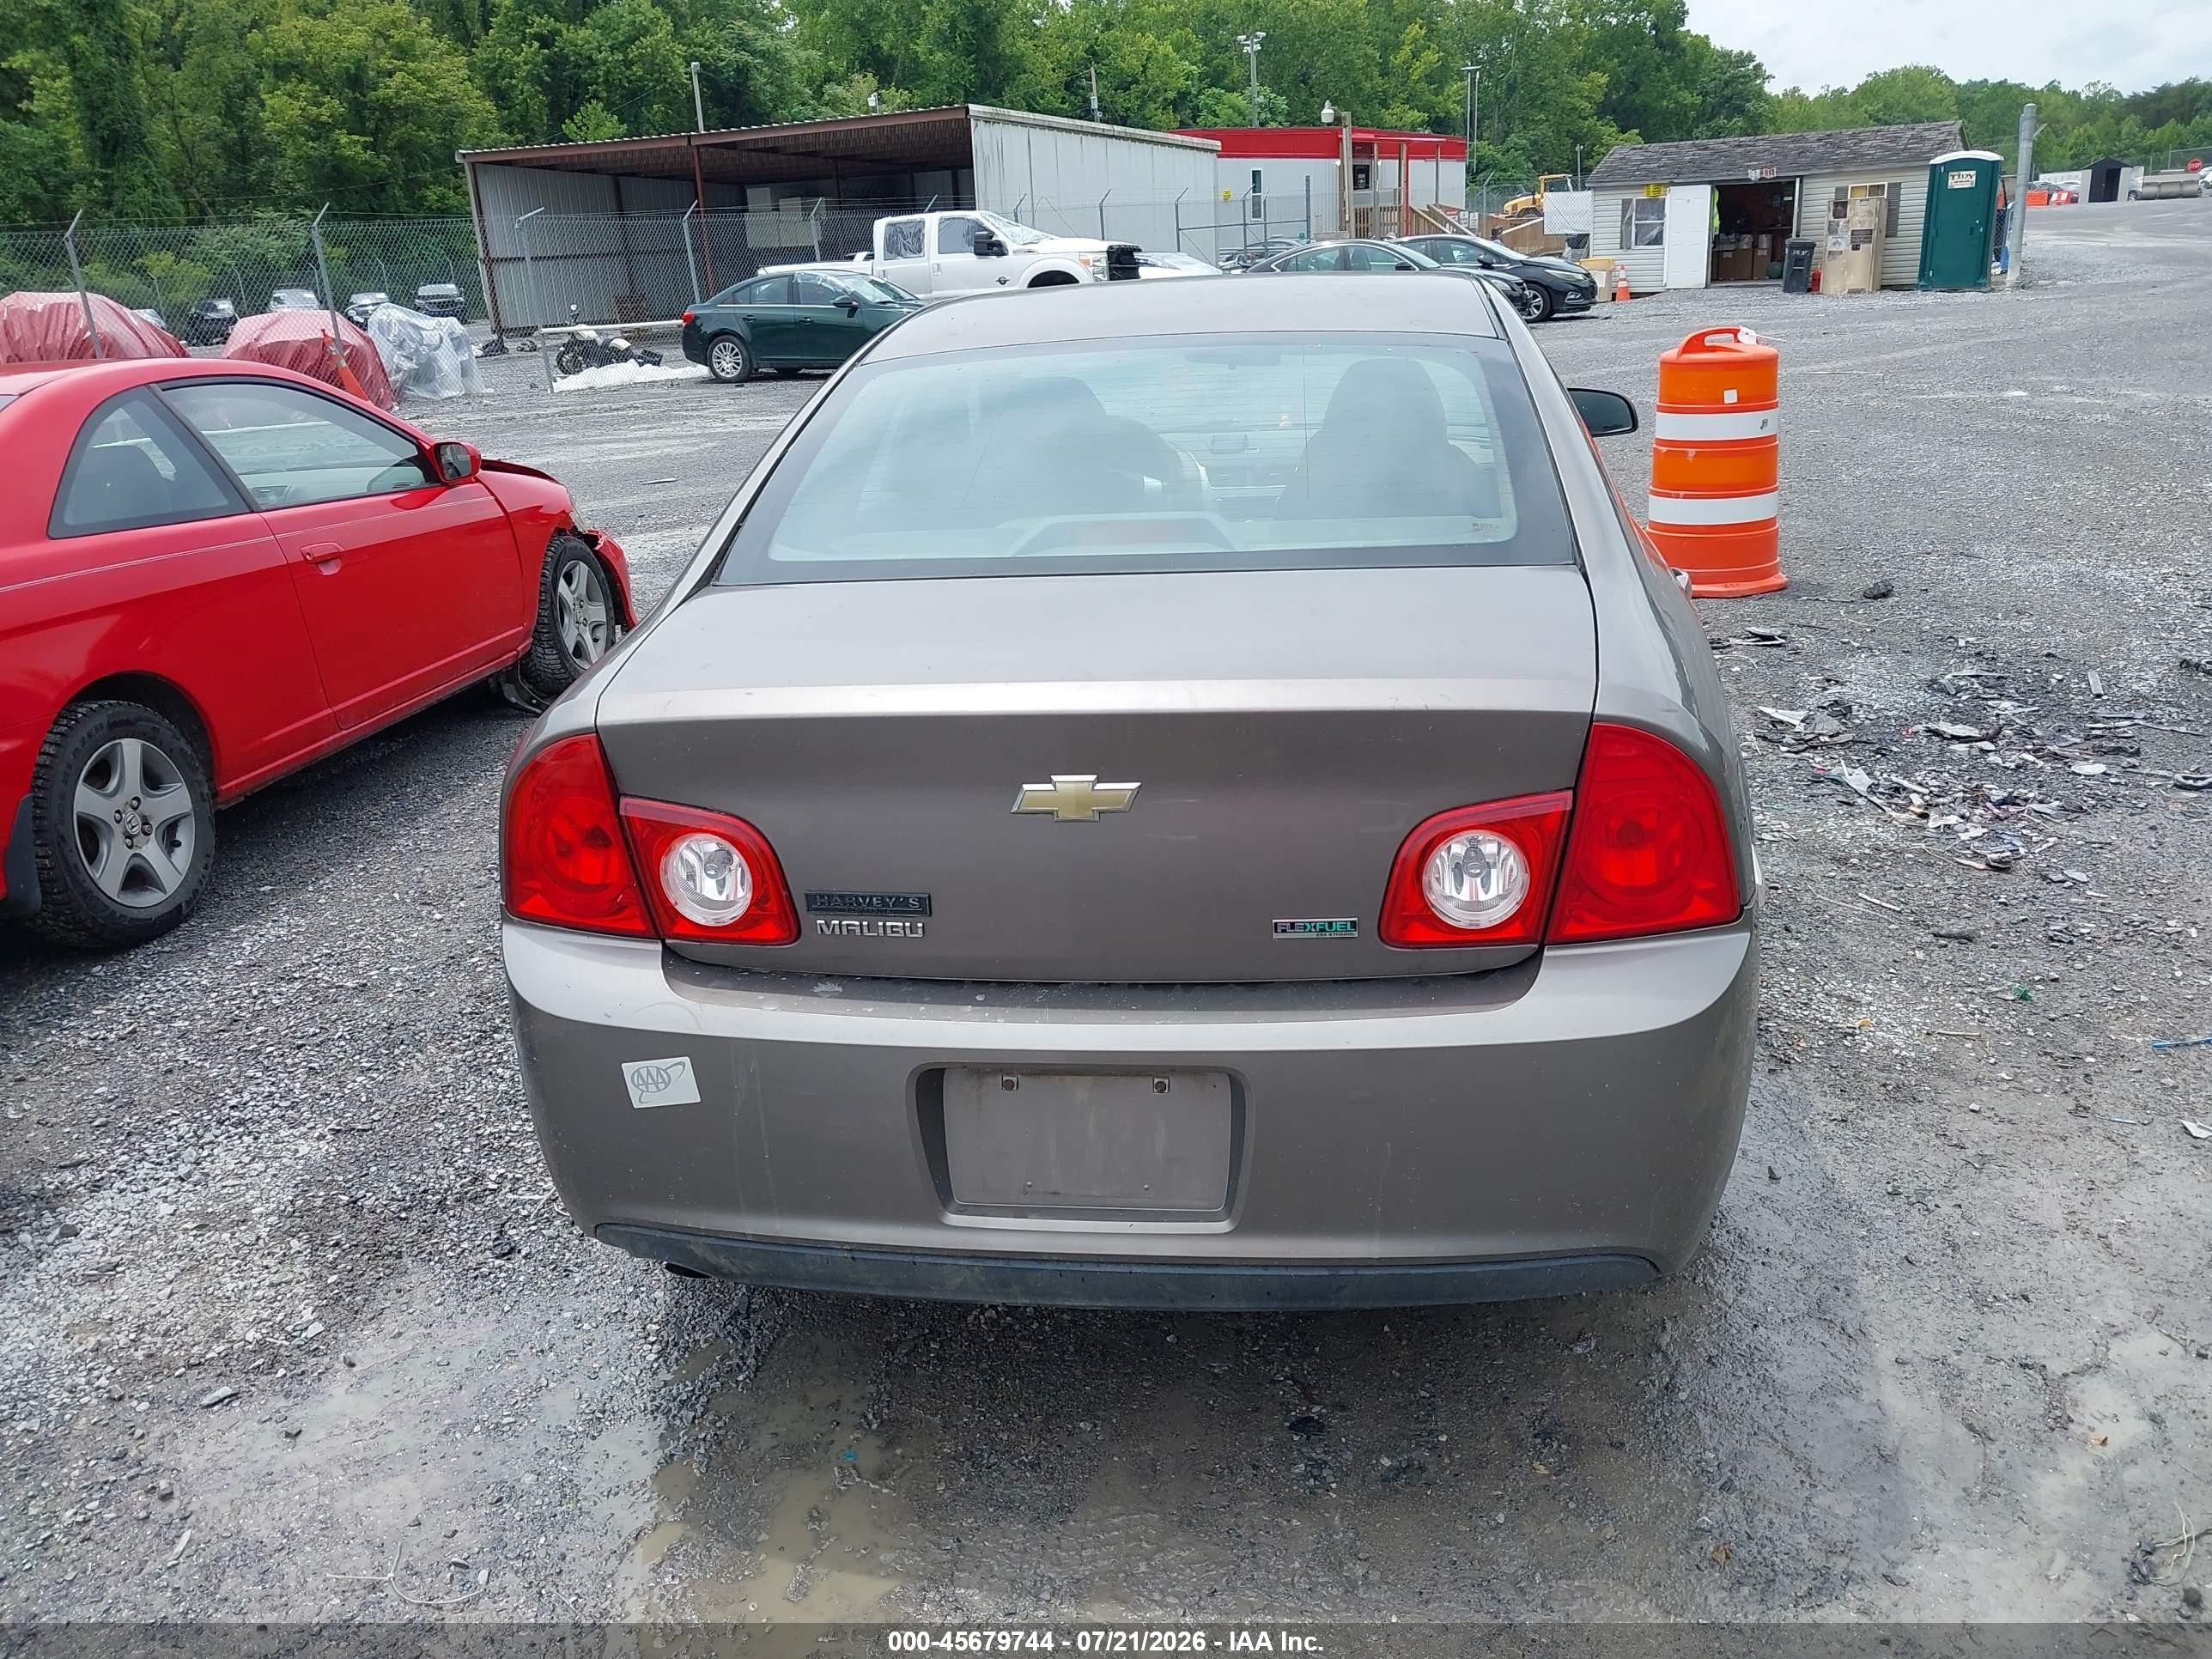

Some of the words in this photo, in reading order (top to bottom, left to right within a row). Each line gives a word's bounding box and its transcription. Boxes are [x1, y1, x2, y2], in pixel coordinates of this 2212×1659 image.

[816, 896, 921, 908] HARVEY'S
[817, 920, 924, 938] MALIBU
[1277, 921, 1355, 933] FLEXFUEL
[635, 1066, 668, 1092] AAA
